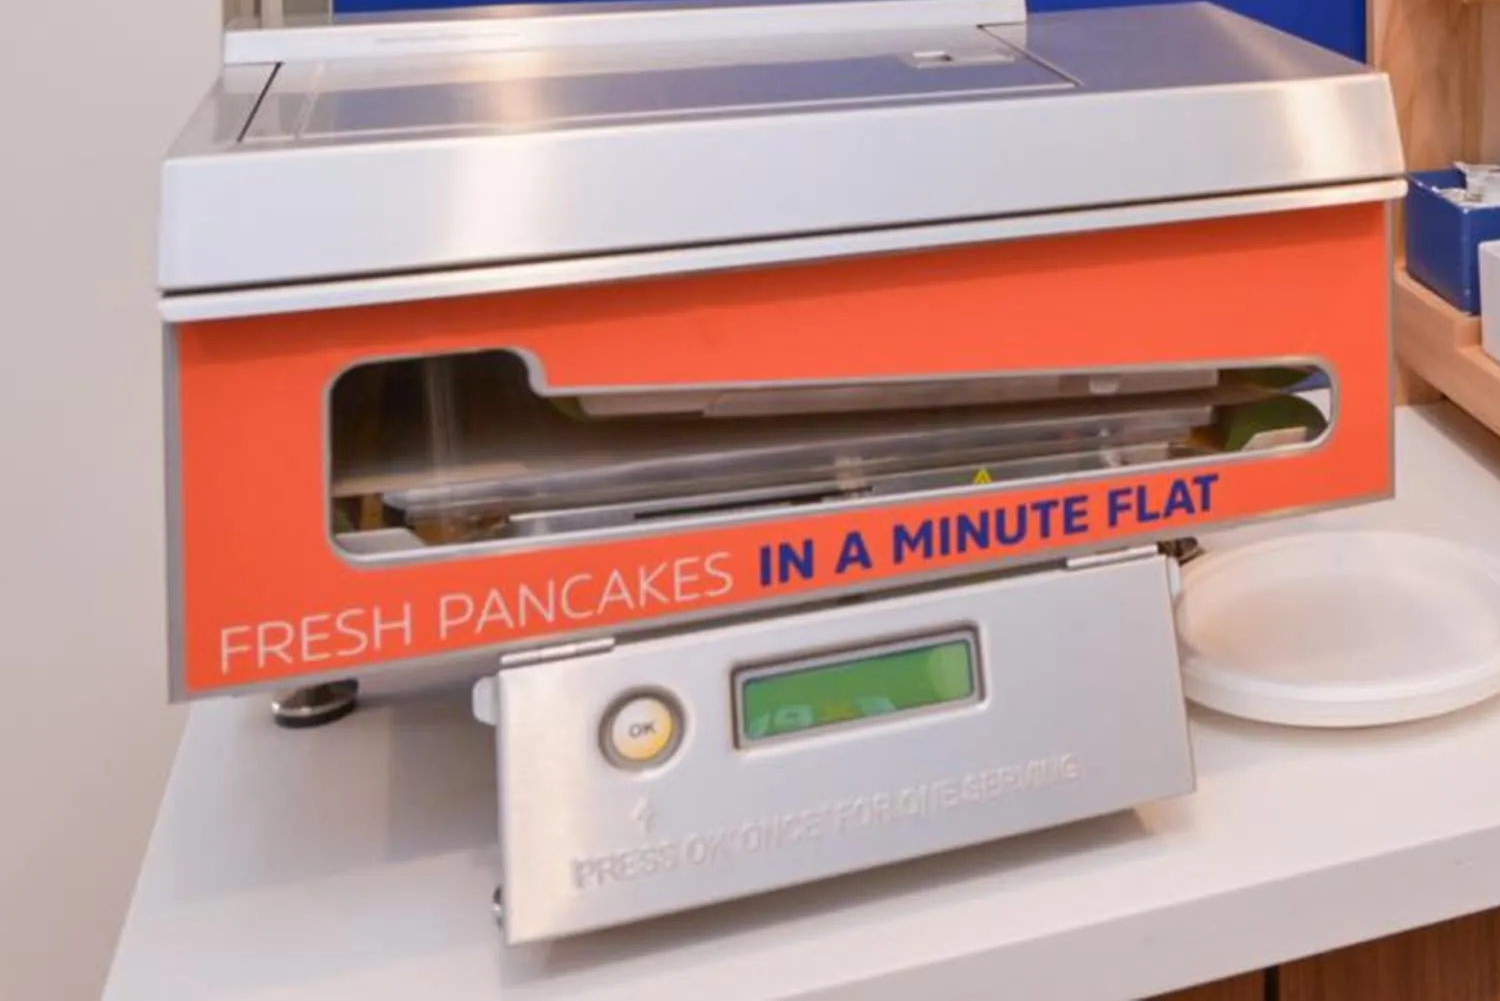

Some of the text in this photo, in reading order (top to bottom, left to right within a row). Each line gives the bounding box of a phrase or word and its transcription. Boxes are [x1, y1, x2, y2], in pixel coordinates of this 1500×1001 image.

[219, 473, 1219, 675] FRESH PANCAKES IN A MINUTE FLAT
[628, 721, 657, 739] OK
[572, 841, 678, 890] PRESS
[836, 794, 893, 835] FOR
